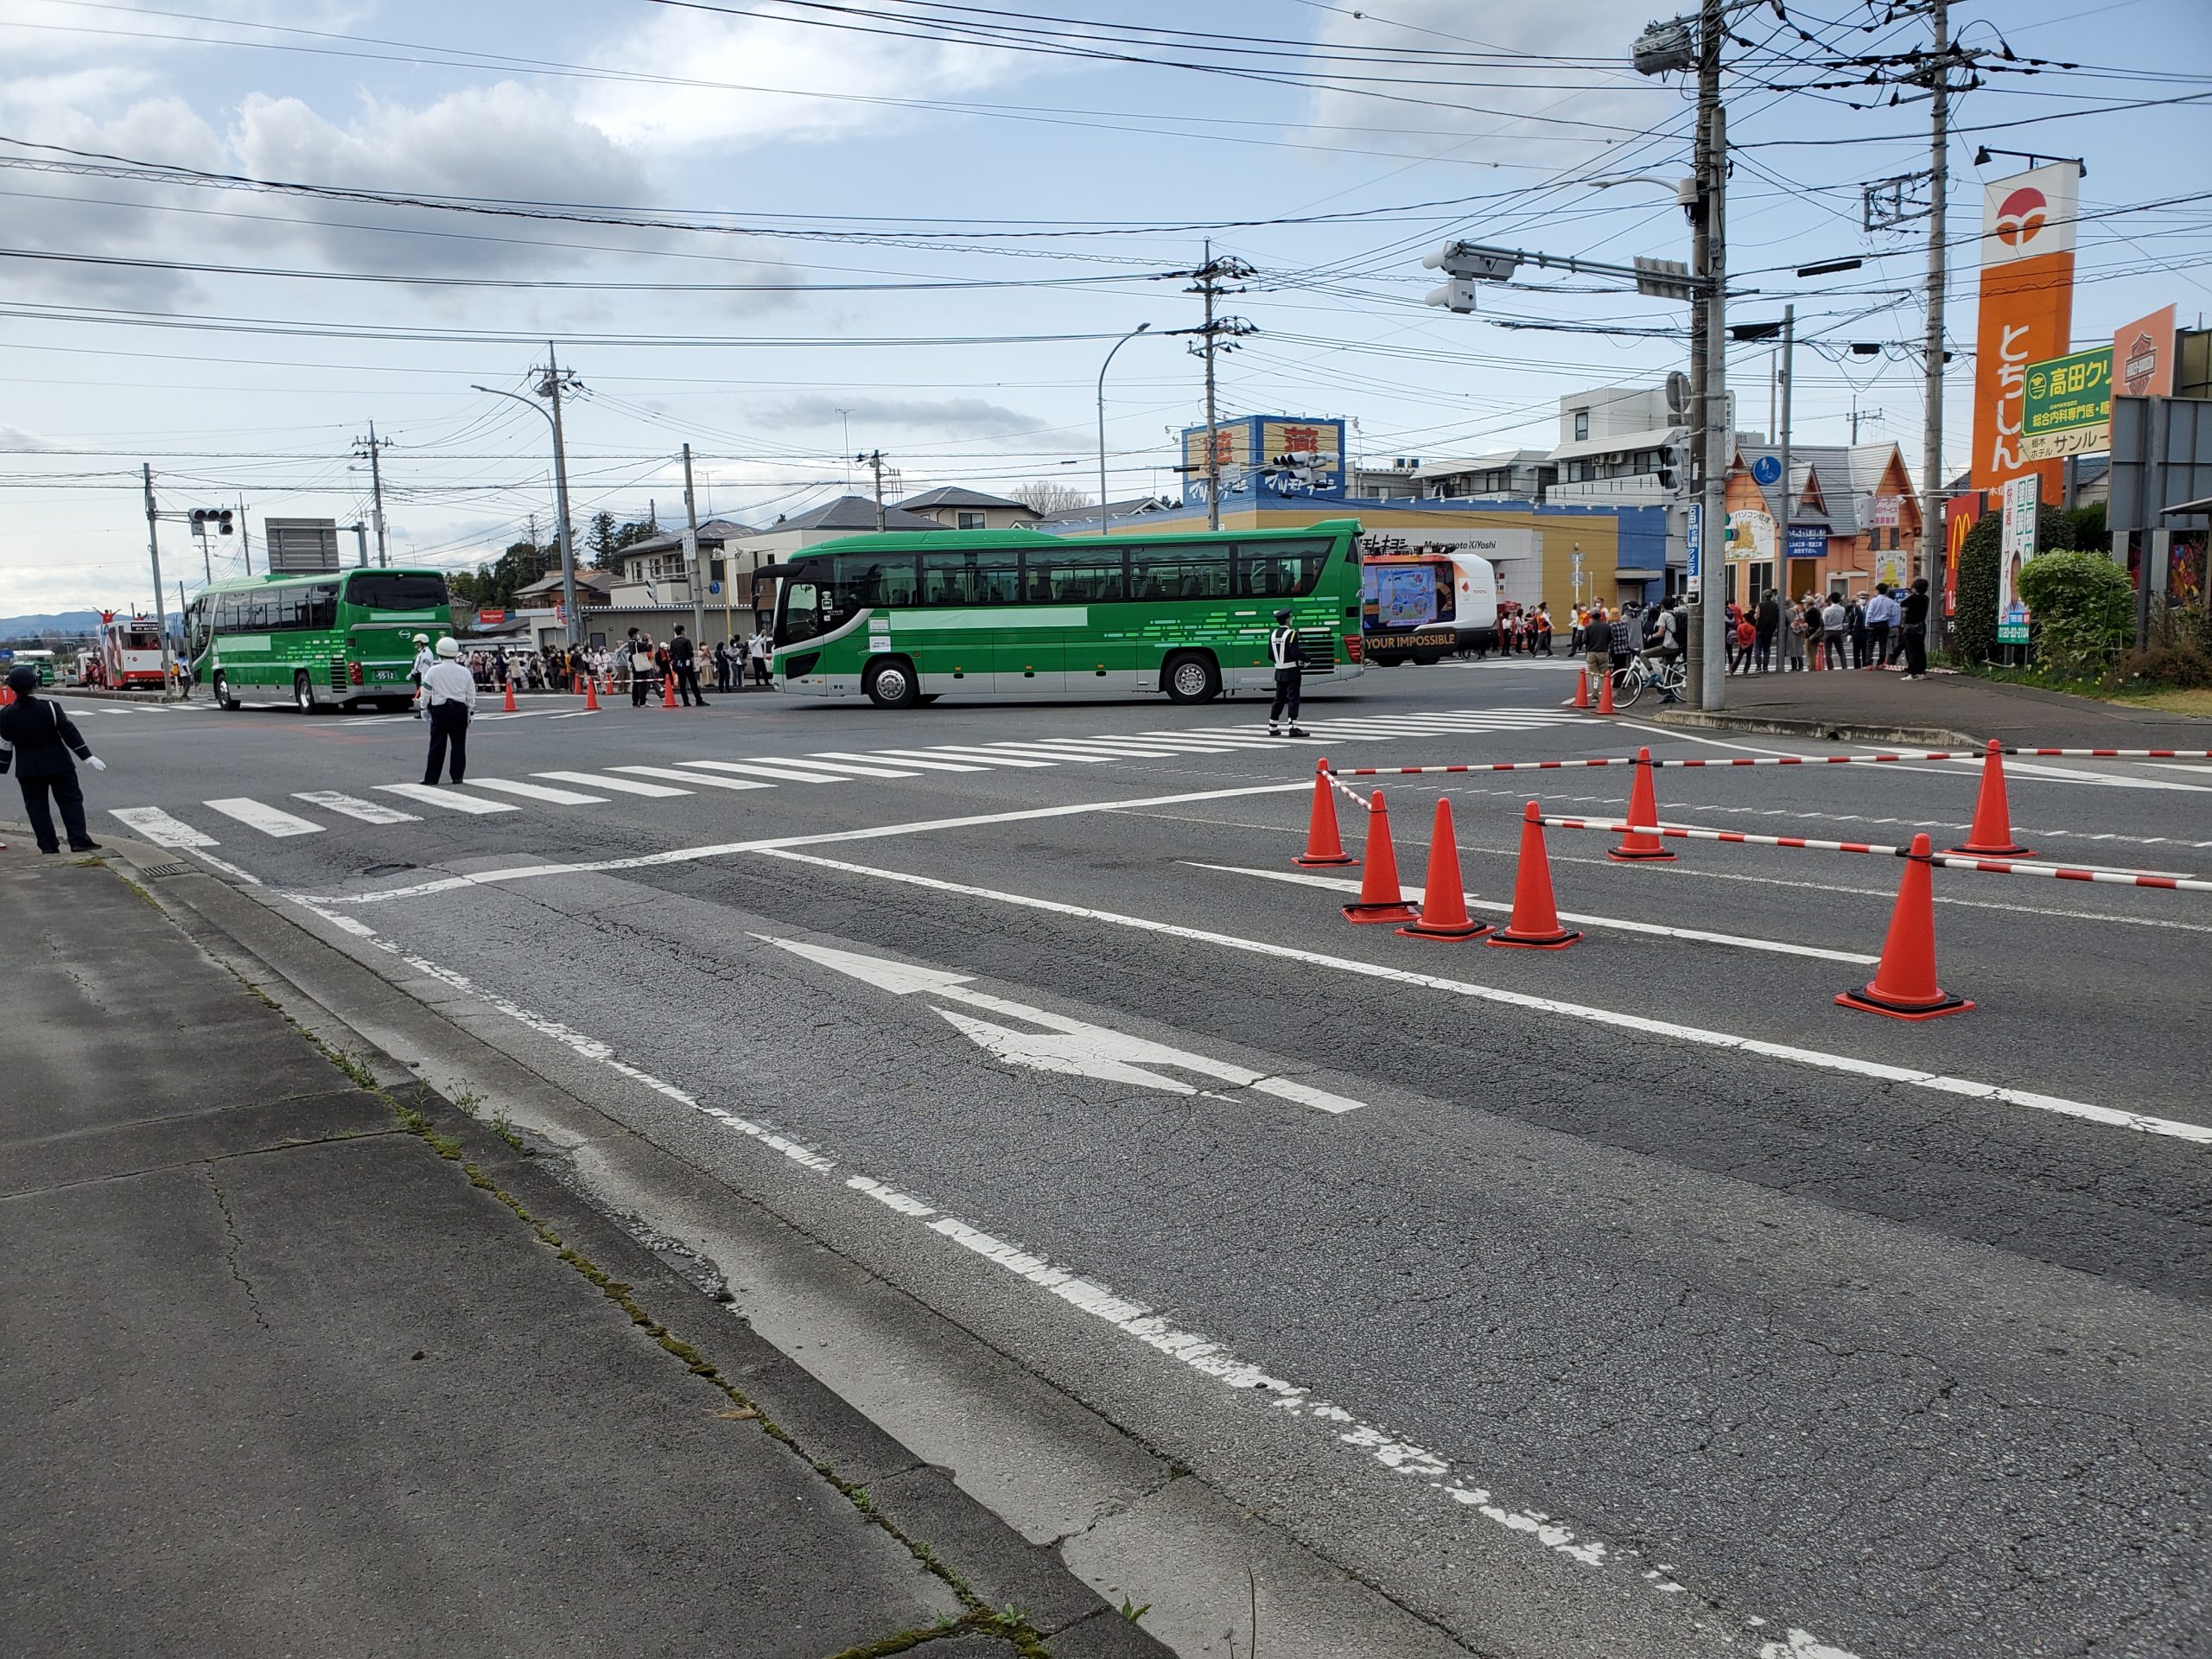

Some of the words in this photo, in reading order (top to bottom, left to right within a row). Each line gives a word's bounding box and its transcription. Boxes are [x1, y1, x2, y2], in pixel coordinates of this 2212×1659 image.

[1993, 325, 2029, 472] とちしん
[2031, 447, 2053, 459] ホテル
[1365, 637, 1395, 650] YOUR
[1396, 633, 1455, 648] IMPOSSIBLE
